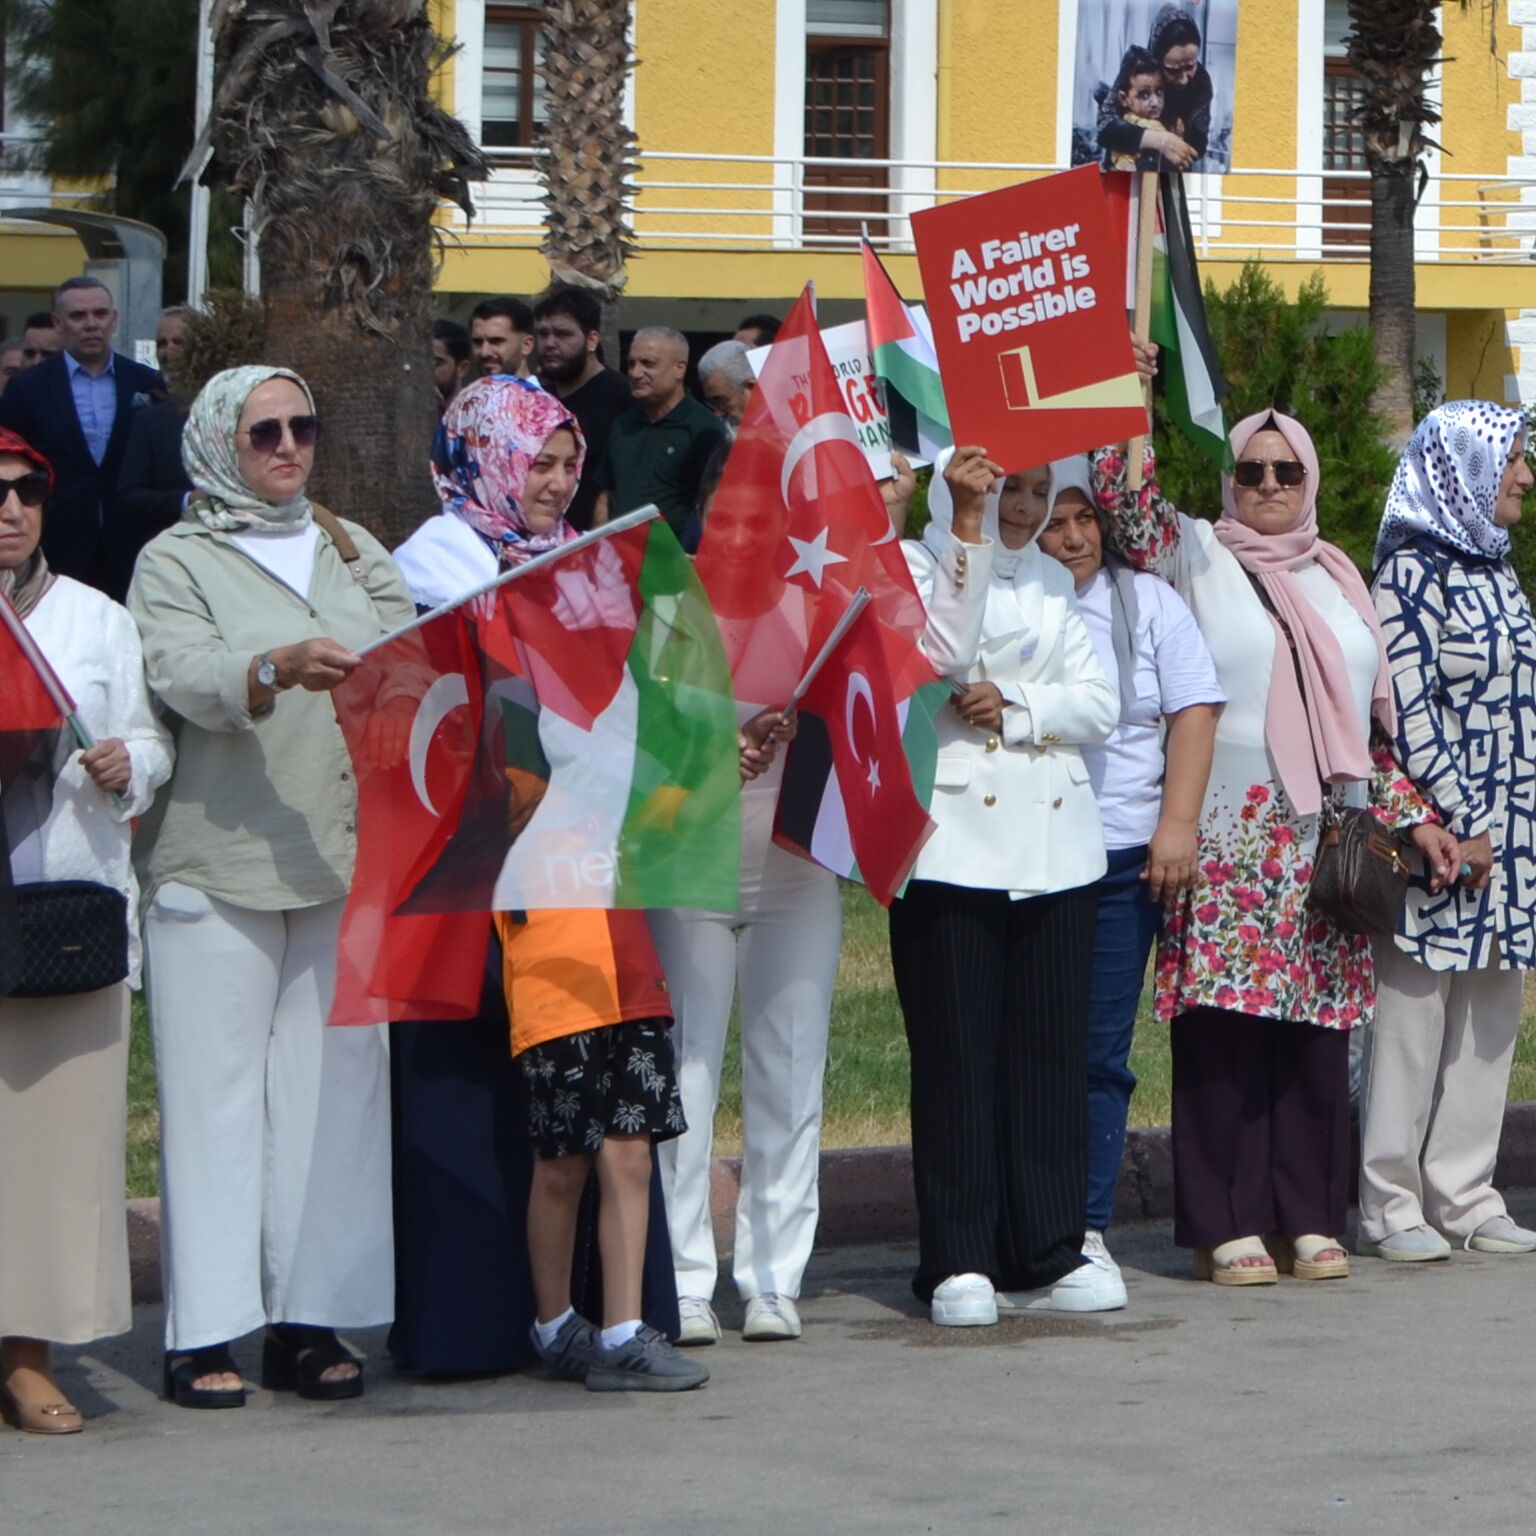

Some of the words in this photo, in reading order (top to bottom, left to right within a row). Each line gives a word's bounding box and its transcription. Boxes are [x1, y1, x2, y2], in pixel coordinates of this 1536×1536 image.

[951, 248, 978, 280] A
[980, 223, 1081, 270] Fairer
[950, 258, 1056, 310] World
[1060, 253, 1091, 281] is
[956, 285, 1097, 343] Possible
